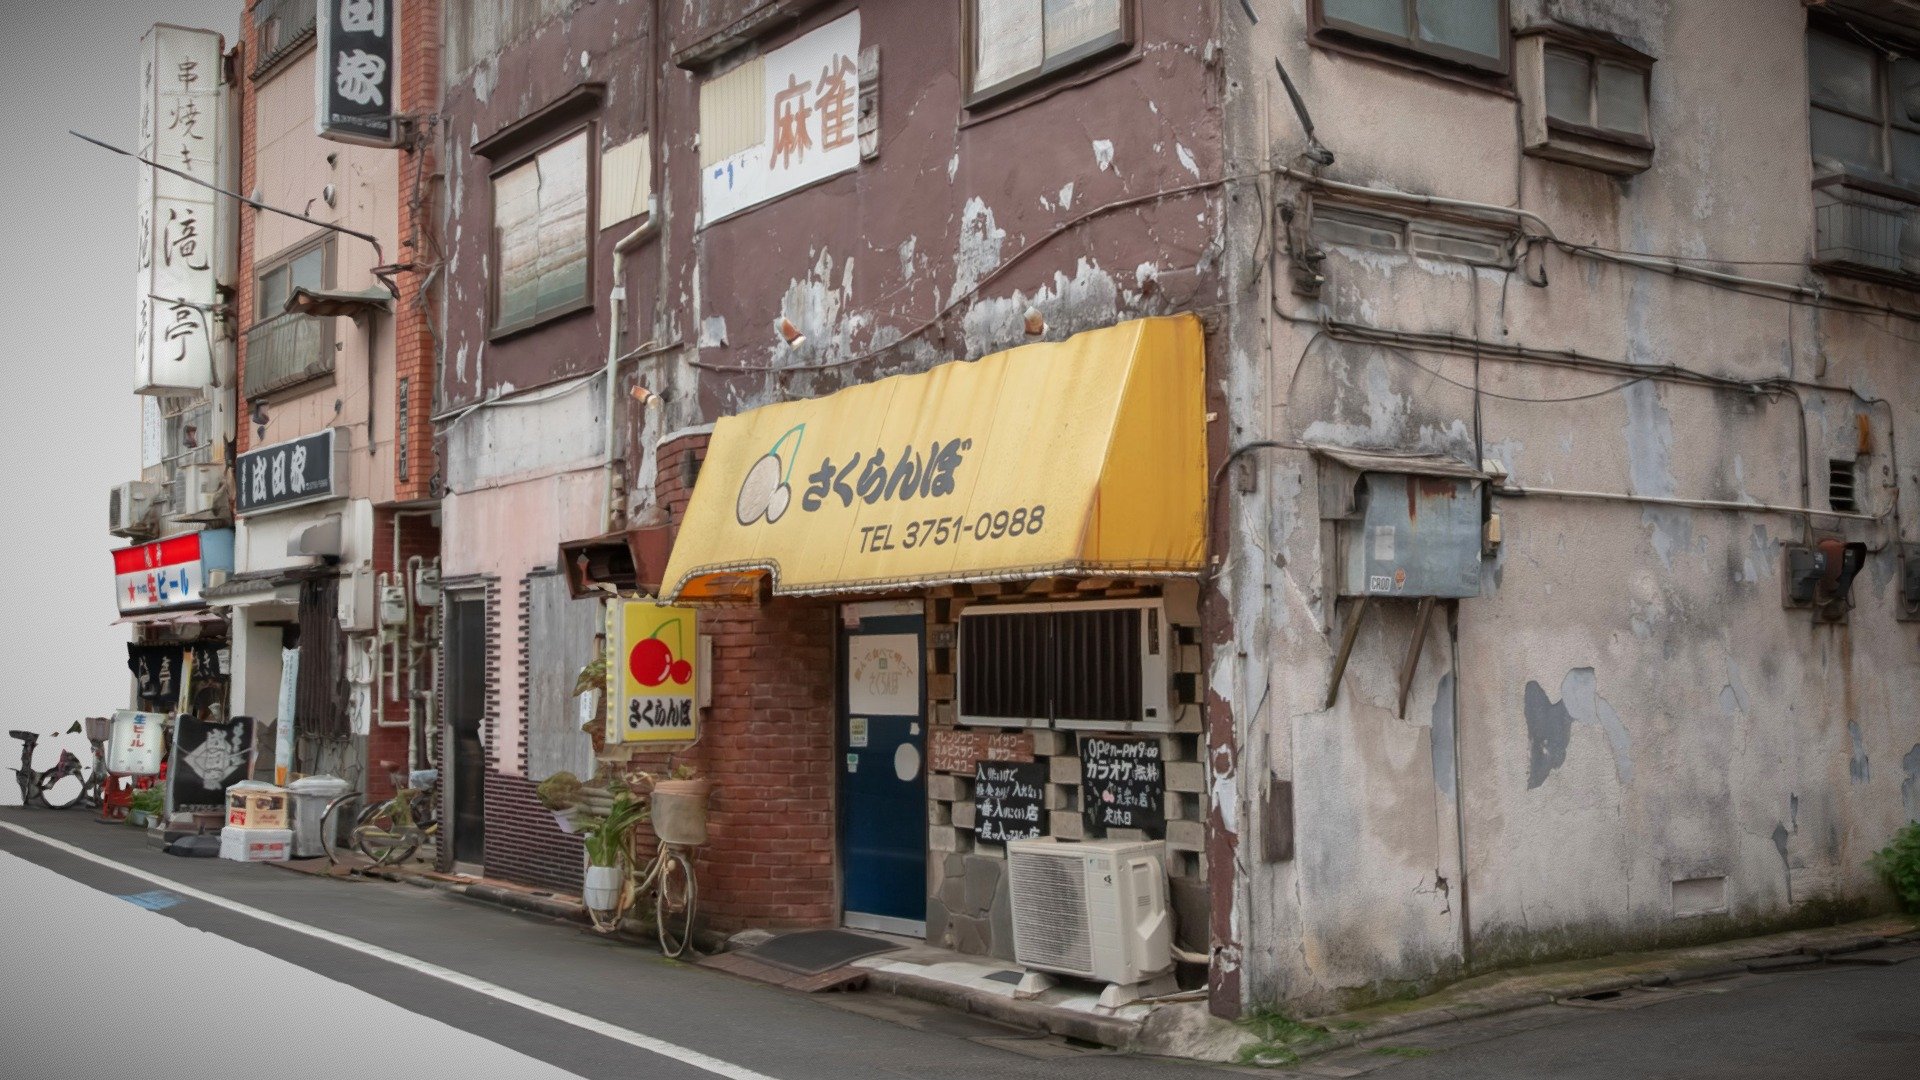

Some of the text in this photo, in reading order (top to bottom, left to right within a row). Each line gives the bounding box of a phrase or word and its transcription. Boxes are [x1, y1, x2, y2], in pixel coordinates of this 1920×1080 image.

[769, 53, 856, 171] 麻雀
[802, 437, 973, 512] さくらんぼ
[860, 505, 1046, 554] TEL 3751-0988
[147, 567, 189, 603] 生ビール
[133, 714, 146, 747] 生ビール
[630, 698, 692, 729] さくらんぼ
